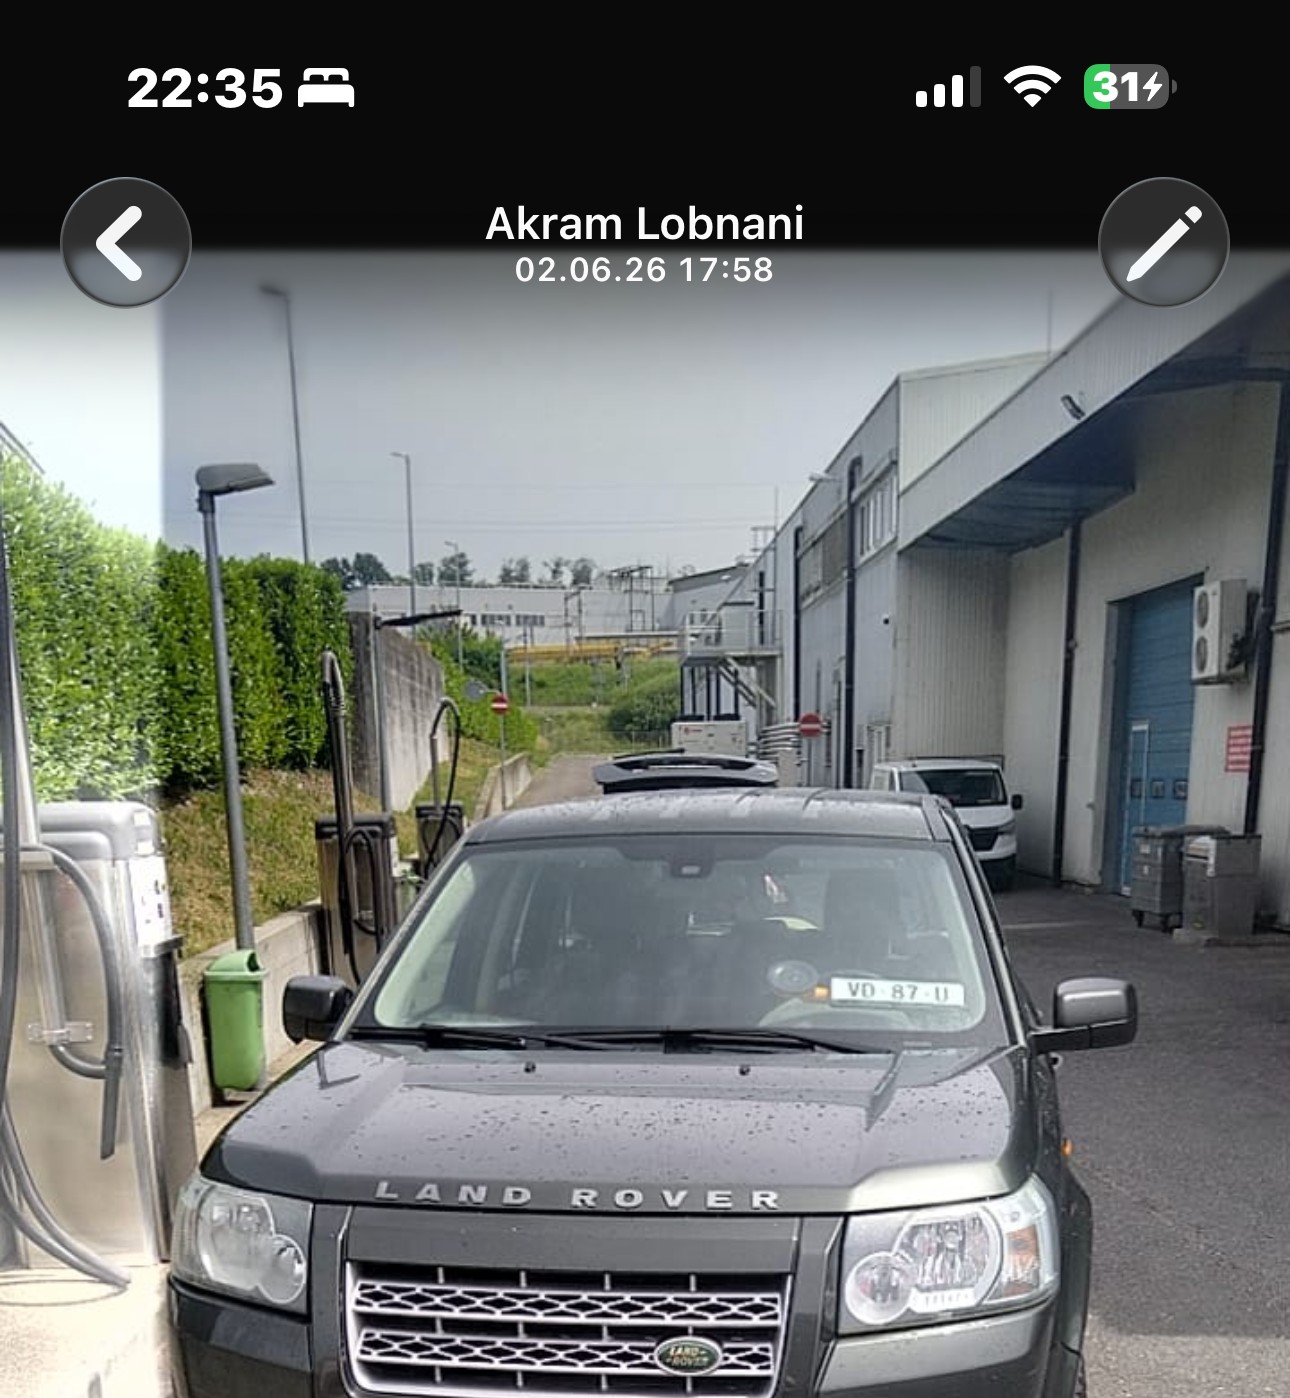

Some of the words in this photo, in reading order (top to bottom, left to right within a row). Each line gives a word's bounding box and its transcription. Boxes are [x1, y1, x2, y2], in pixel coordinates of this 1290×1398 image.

[847, 981, 876, 998] VD
[891, 984, 918, 1000] 87
[375, 1181, 532, 1206] LAND
[571, 1189, 779, 1210] ROVER
